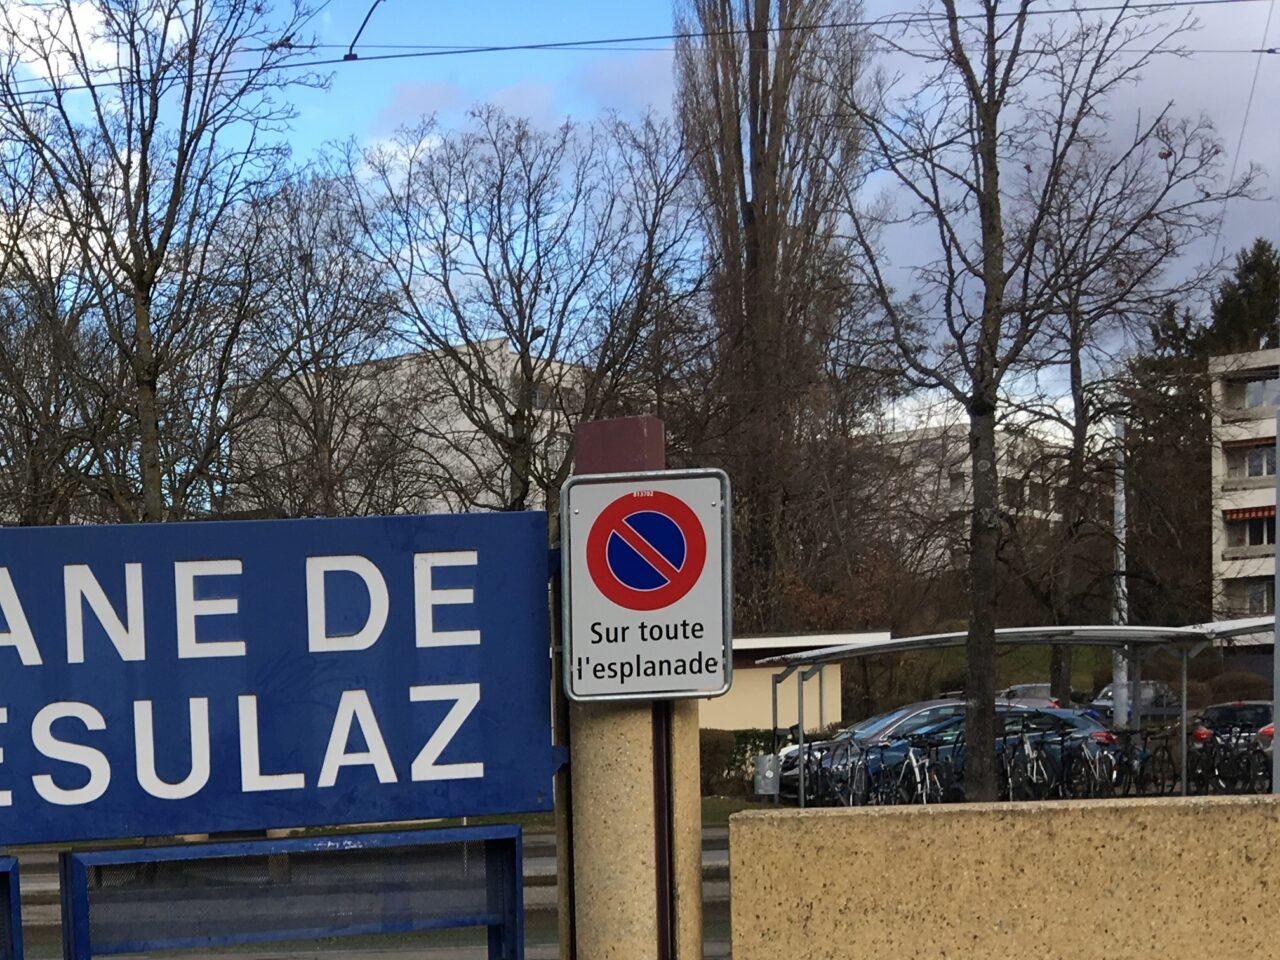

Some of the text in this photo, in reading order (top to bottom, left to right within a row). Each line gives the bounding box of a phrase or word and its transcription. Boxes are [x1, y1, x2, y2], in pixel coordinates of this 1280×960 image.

[305, 549, 481, 653] DE
[590, 619, 705, 644] Sur toute
[577, 651, 719, 685] l'esplanade
